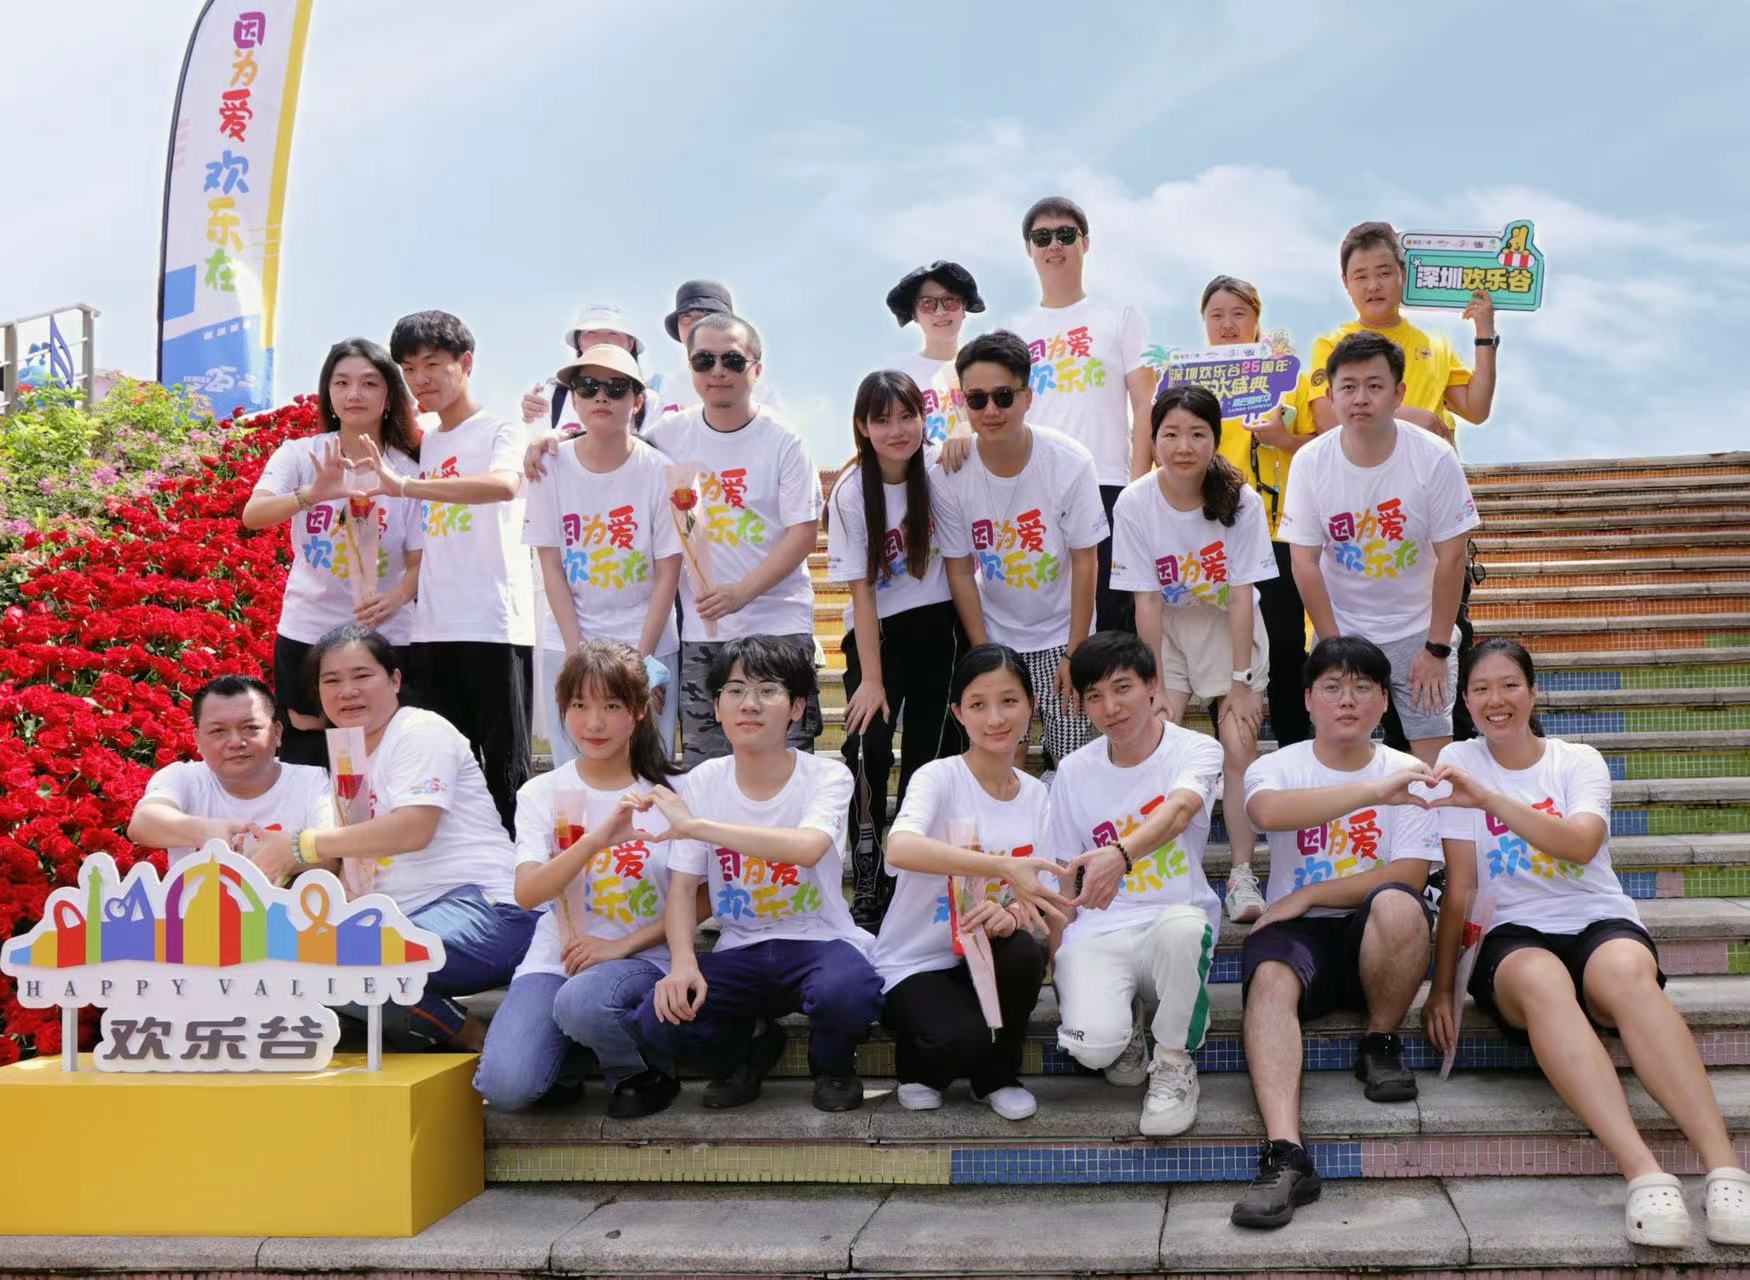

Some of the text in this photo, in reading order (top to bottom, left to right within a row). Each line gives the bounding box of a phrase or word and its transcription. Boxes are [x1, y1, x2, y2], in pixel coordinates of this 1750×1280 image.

[1416, 265, 1533, 294] 深圳欢乐谷
[1028, 326, 1093, 363] 因为爱
[1029, 357, 1106, 395] 欢乐在
[1191, 375, 1272, 401] 欢盛典
[699, 468, 748, 510] 为爱
[422, 501, 473, 537] 乐在
[562, 505, 638, 550] 因为爱
[703, 505, 766, 548] 乐在
[972, 508, 1047, 552] 因为爱
[1329, 498, 1407, 542] 因为爱
[1155, 541, 1228, 586] 因为爱
[1334, 540, 1419, 579] 欢乐在
[1296, 809, 1383, 861] 因为爱
[585, 836, 650, 880] 为爱
[1120, 840, 1189, 894] 乐在
[585, 877, 658, 925] 乐在
[26, 979, 184, 998] HAPPY
[103, 1016, 324, 1060] 欢乐谷
